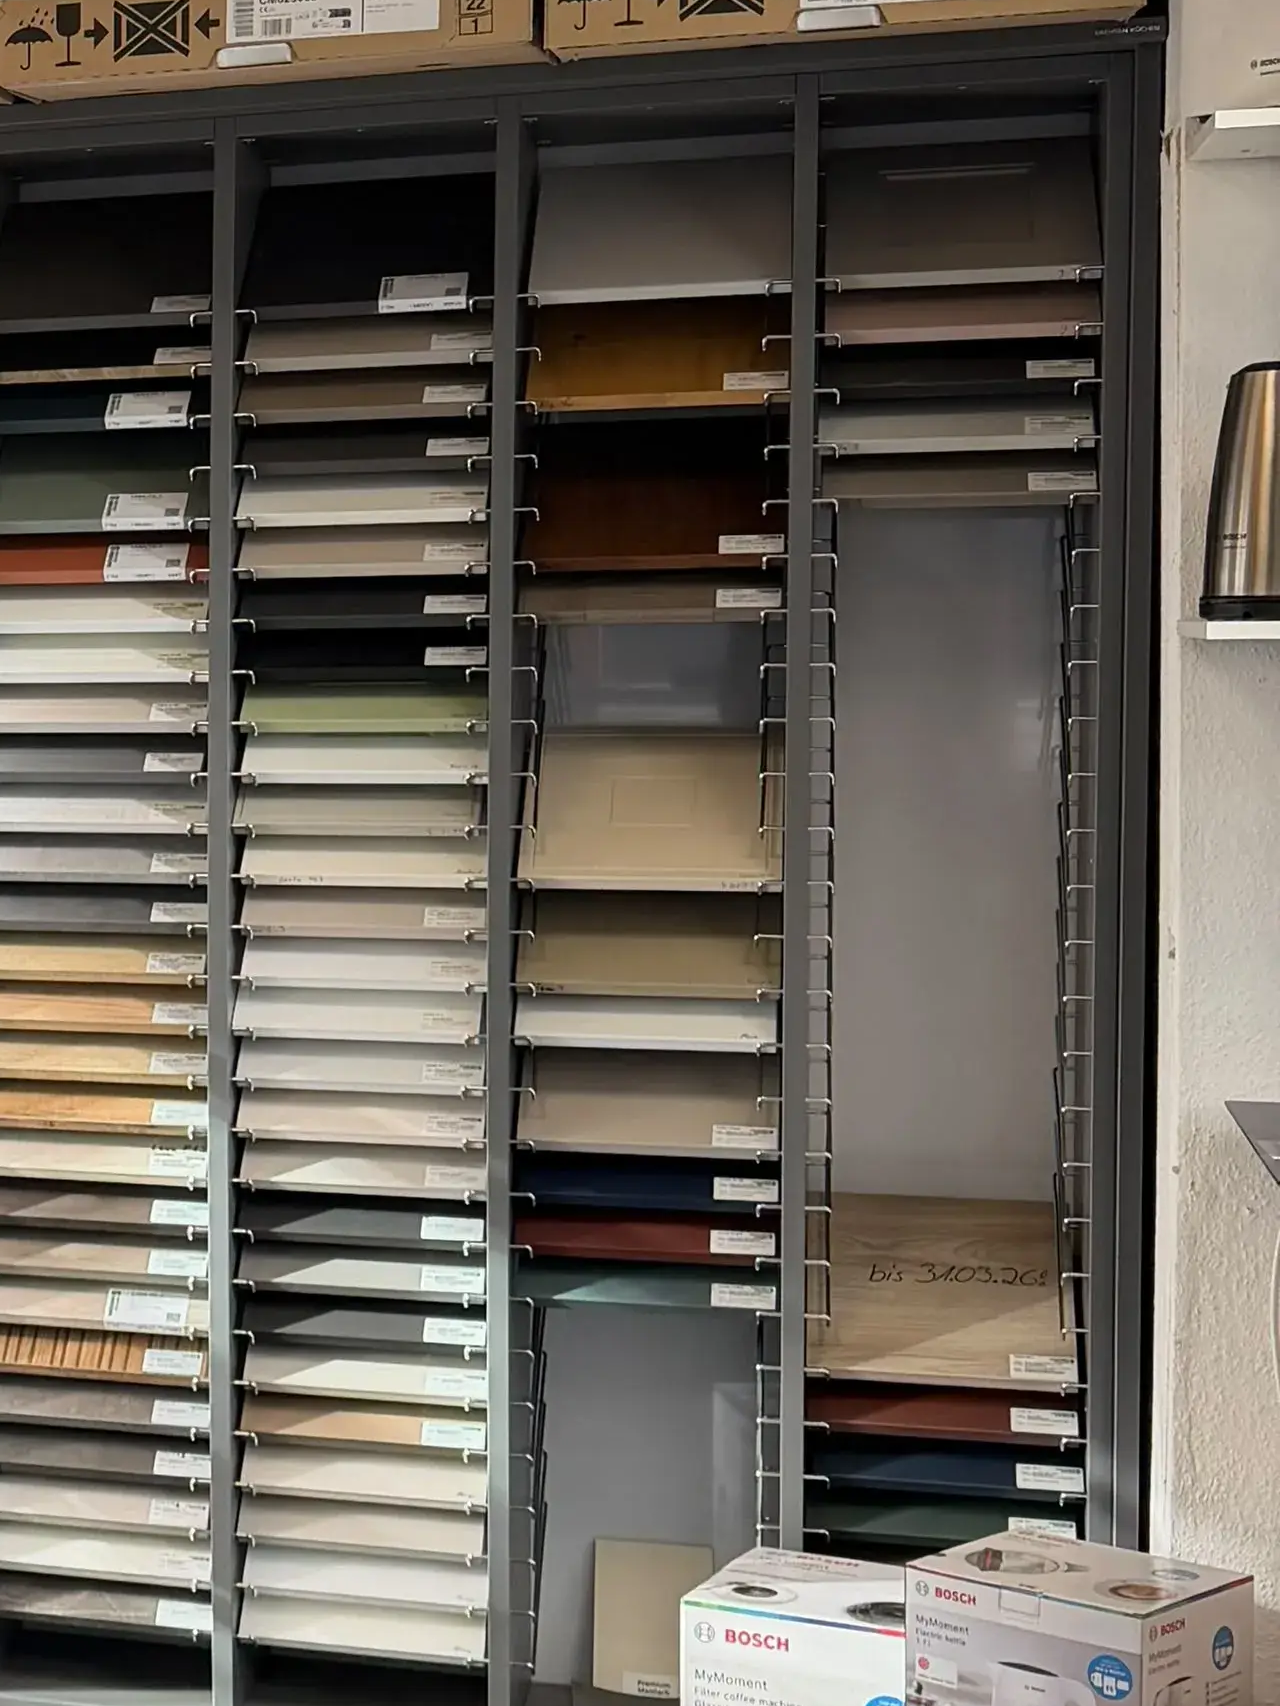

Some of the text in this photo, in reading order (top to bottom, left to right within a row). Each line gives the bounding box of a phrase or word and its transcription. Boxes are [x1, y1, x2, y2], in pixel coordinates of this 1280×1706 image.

[471, 18, 479, 33] 1
[868, 1263, 903, 1284] bis
[935, 1586, 976, 1606] BOSCH
[915, 1614, 969, 1635] MyMoment
[1160, 1618, 1186, 1636] BOSCH
[725, 1628, 789, 1652] BOSCH
[694, 1669, 768, 1691] MyMoment
[694, 1688, 720, 1699] Filter
[723, 1691, 755, 1705] coffee
